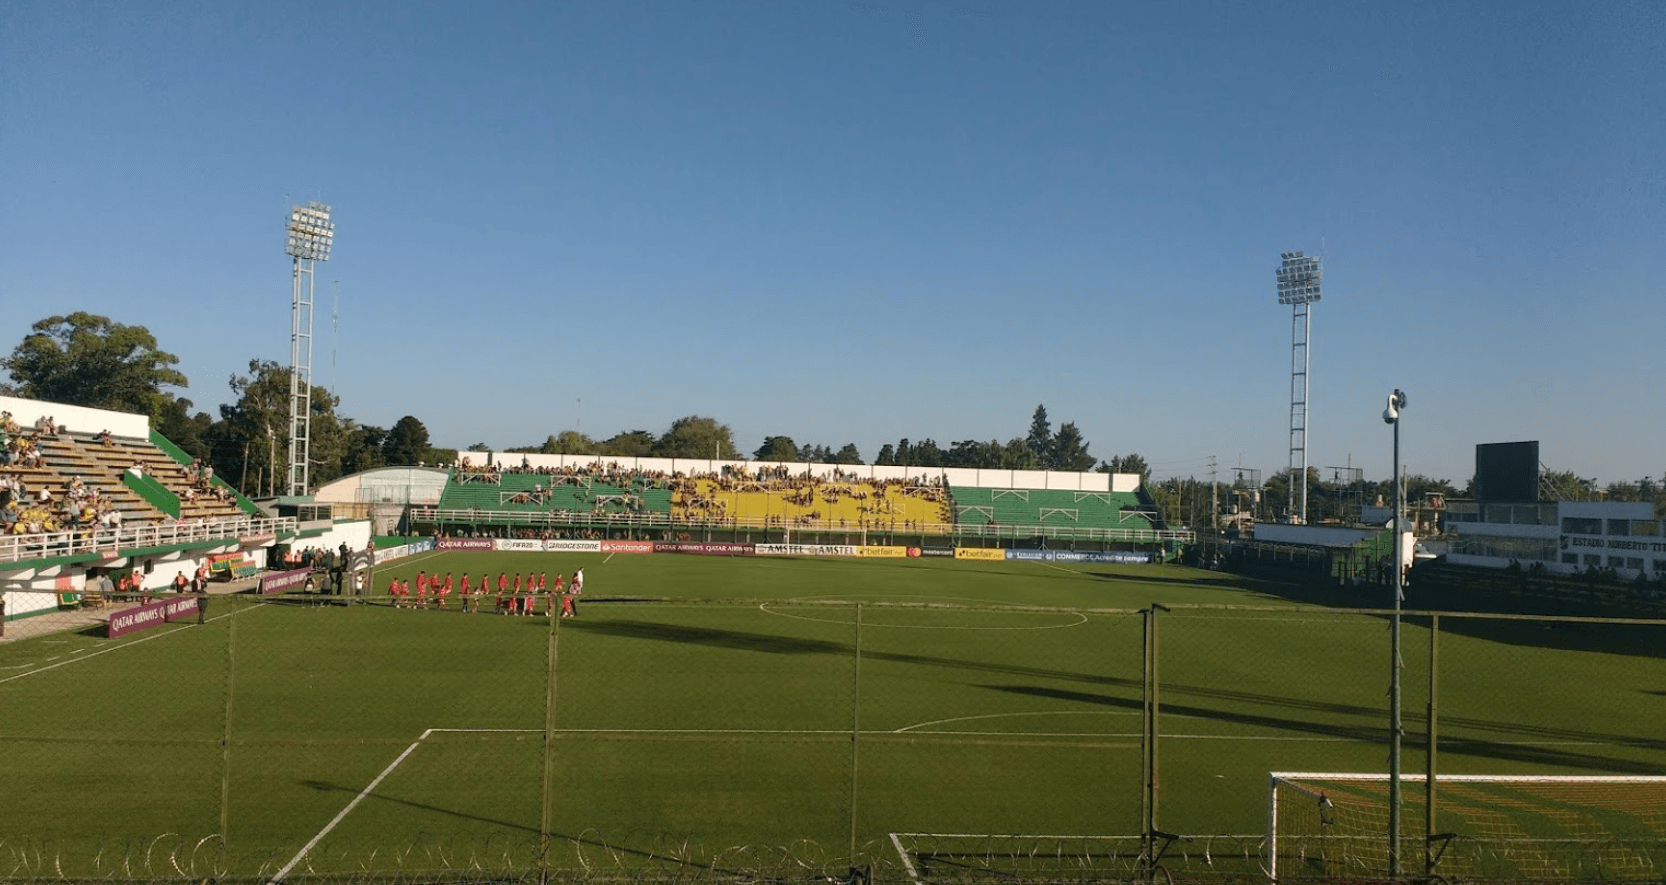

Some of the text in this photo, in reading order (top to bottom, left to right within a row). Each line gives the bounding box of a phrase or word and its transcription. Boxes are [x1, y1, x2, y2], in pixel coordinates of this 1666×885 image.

[548, 542, 599, 550] BRIDGESTONE
[611, 543, 650, 551] Santander
[1572, 537, 1604, 548] ESTADIO
[1607, 540, 1648, 550] NORBERTO
[819, 546, 853, 555] AMSTEL
[159, 602, 177, 619] QTAR
[112, 607, 158, 632] QATAR AIRWAYS
